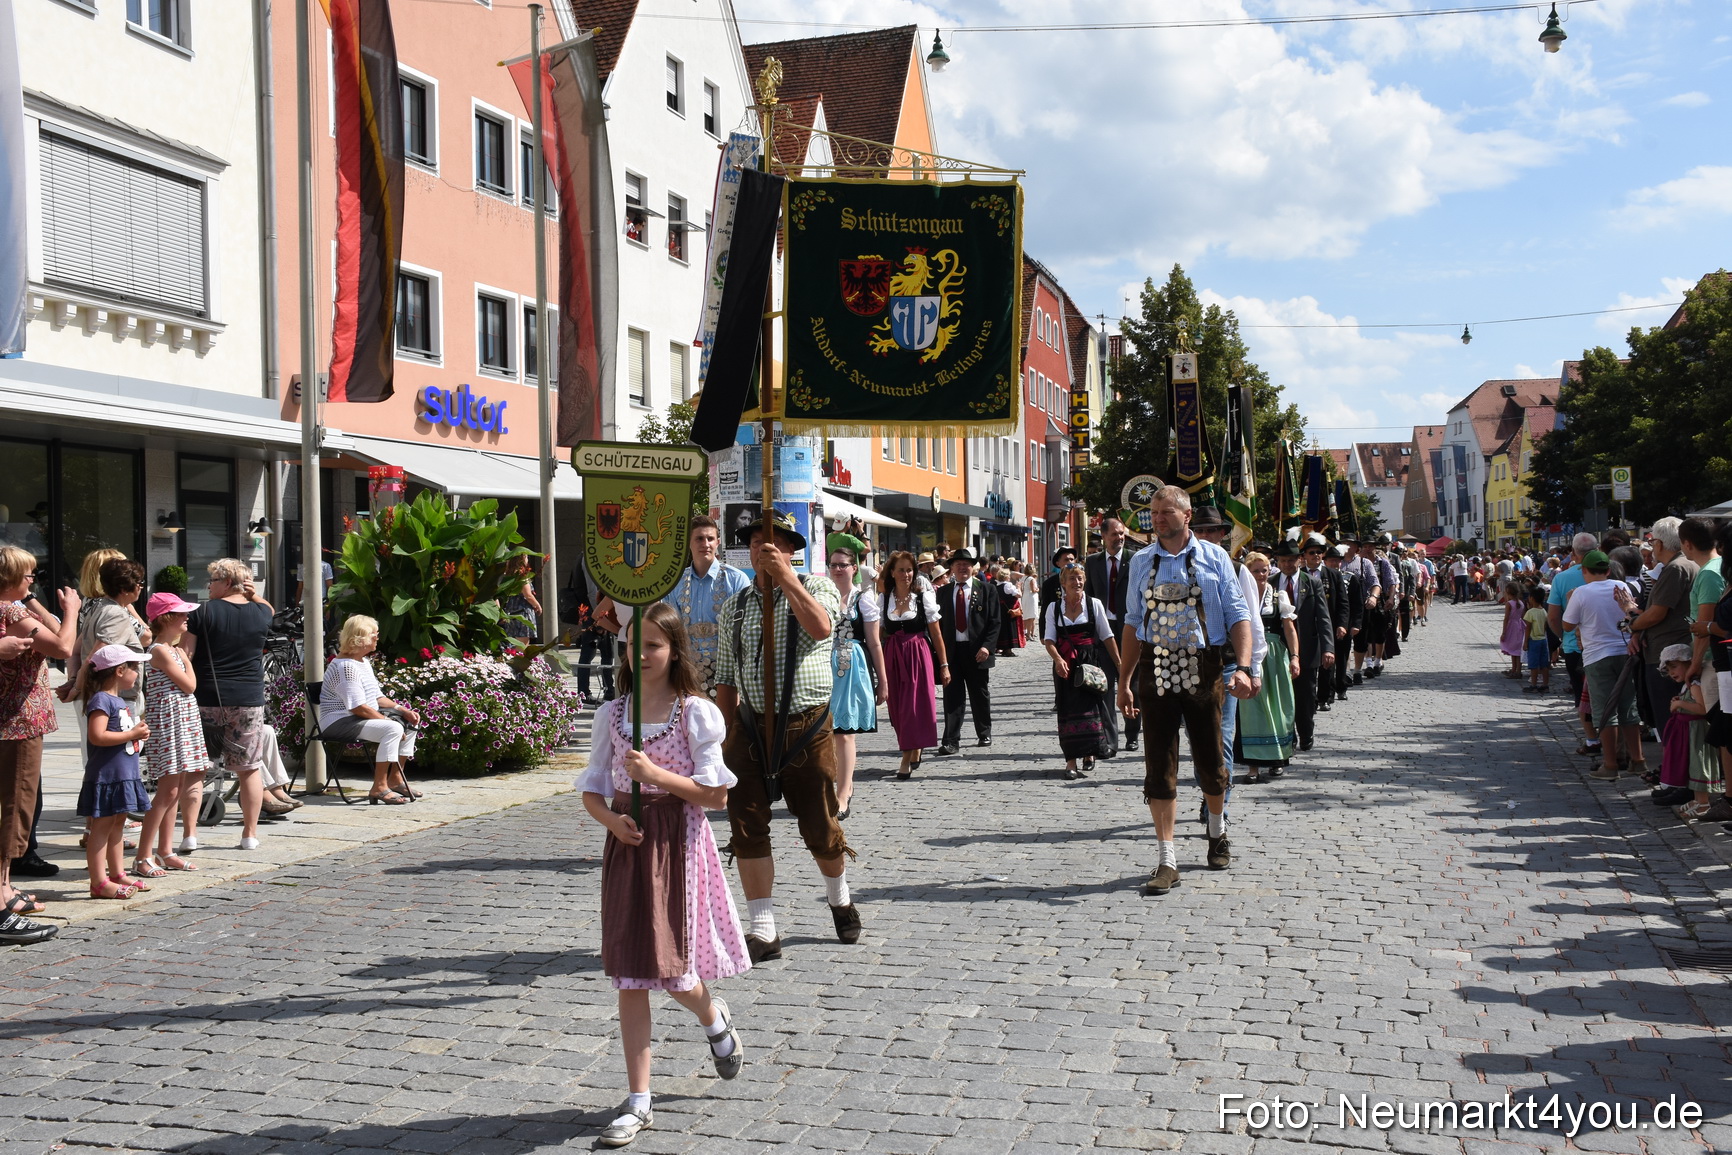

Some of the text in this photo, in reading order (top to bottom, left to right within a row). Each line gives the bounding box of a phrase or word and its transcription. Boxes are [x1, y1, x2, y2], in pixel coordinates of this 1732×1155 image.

[840, 207, 964, 239] Schützengau
[584, 451, 692, 471] SCHÜTZENGAU
[586, 513, 686, 600] ALTDORF-NEUMARKT-BEILNGRIES
